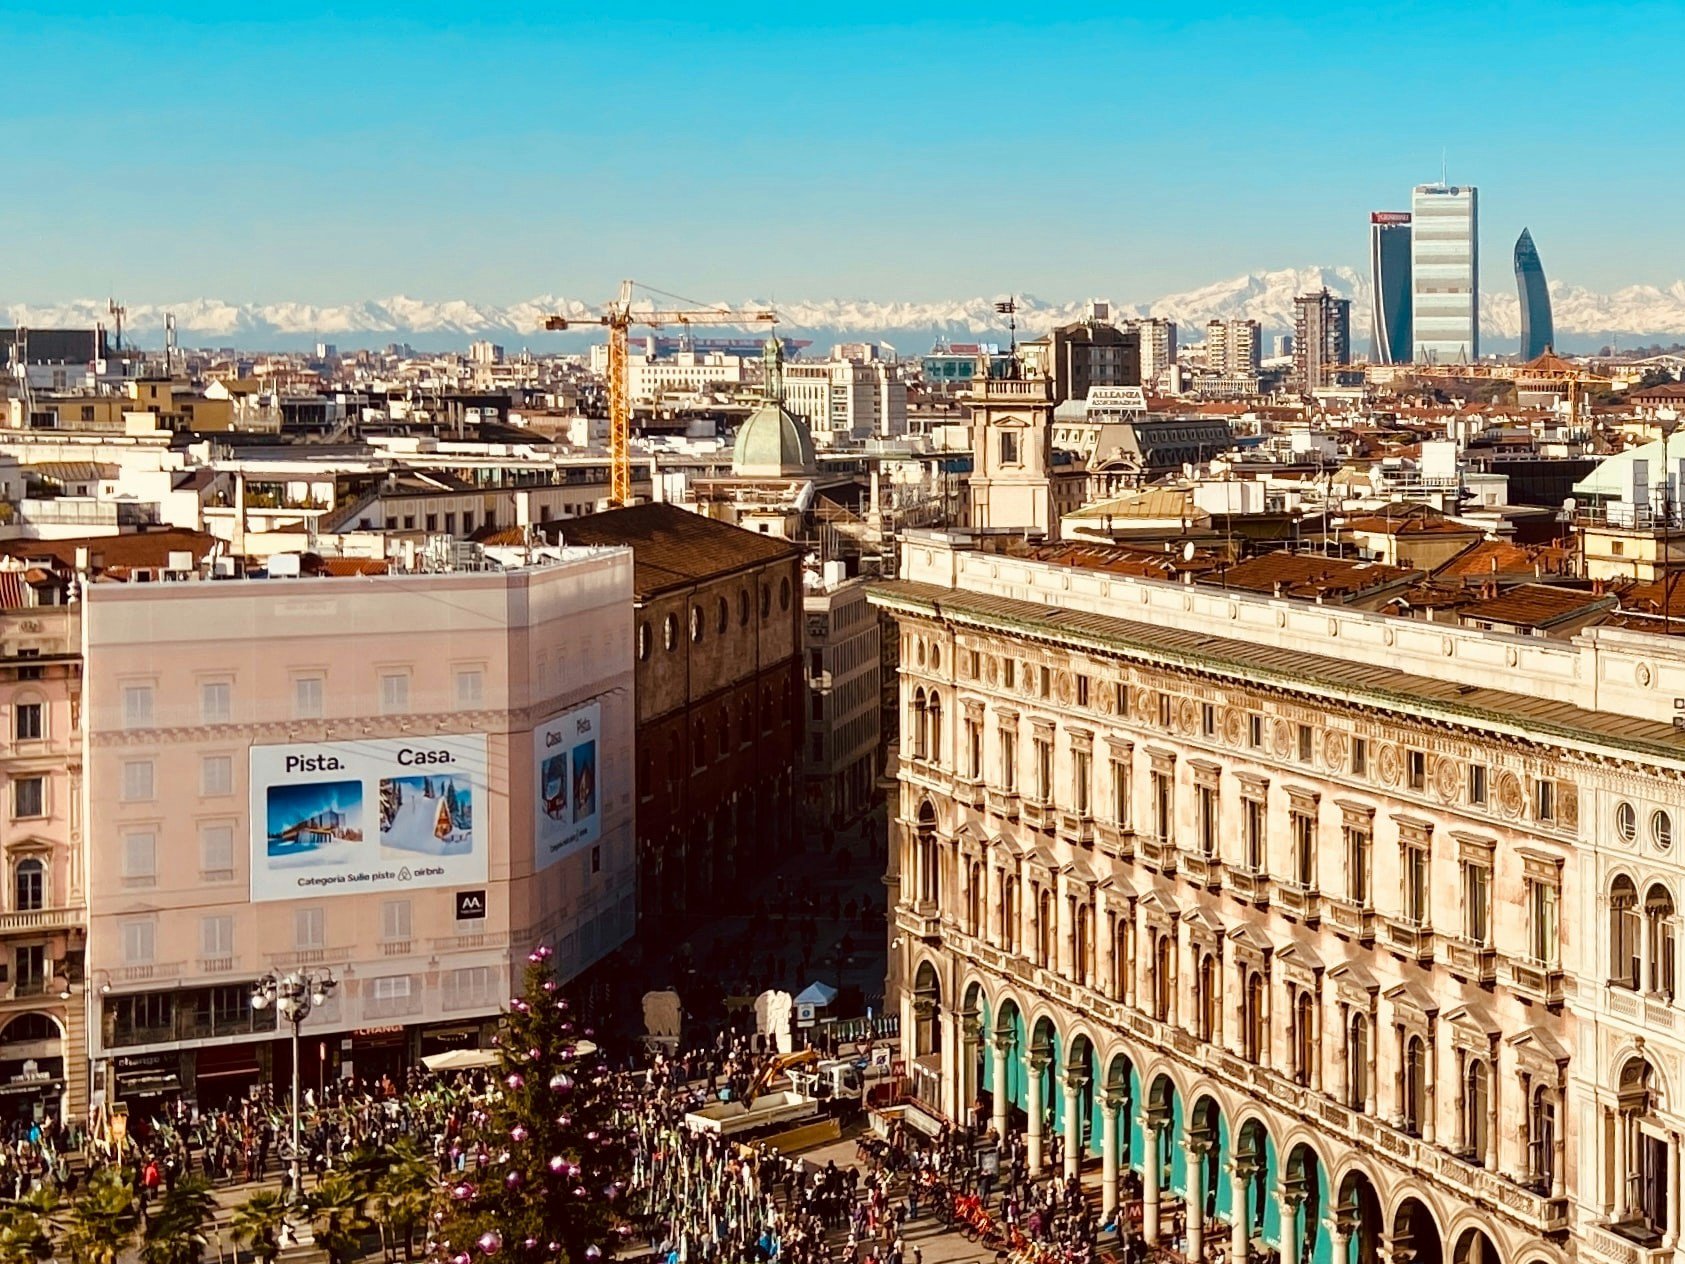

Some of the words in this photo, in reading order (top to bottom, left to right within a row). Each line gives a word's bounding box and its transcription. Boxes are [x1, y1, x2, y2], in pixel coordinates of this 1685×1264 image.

[286, 754, 345, 773] Pista.
[397, 748, 456, 766] Casa.
[297, 872, 346, 888] Categoria
